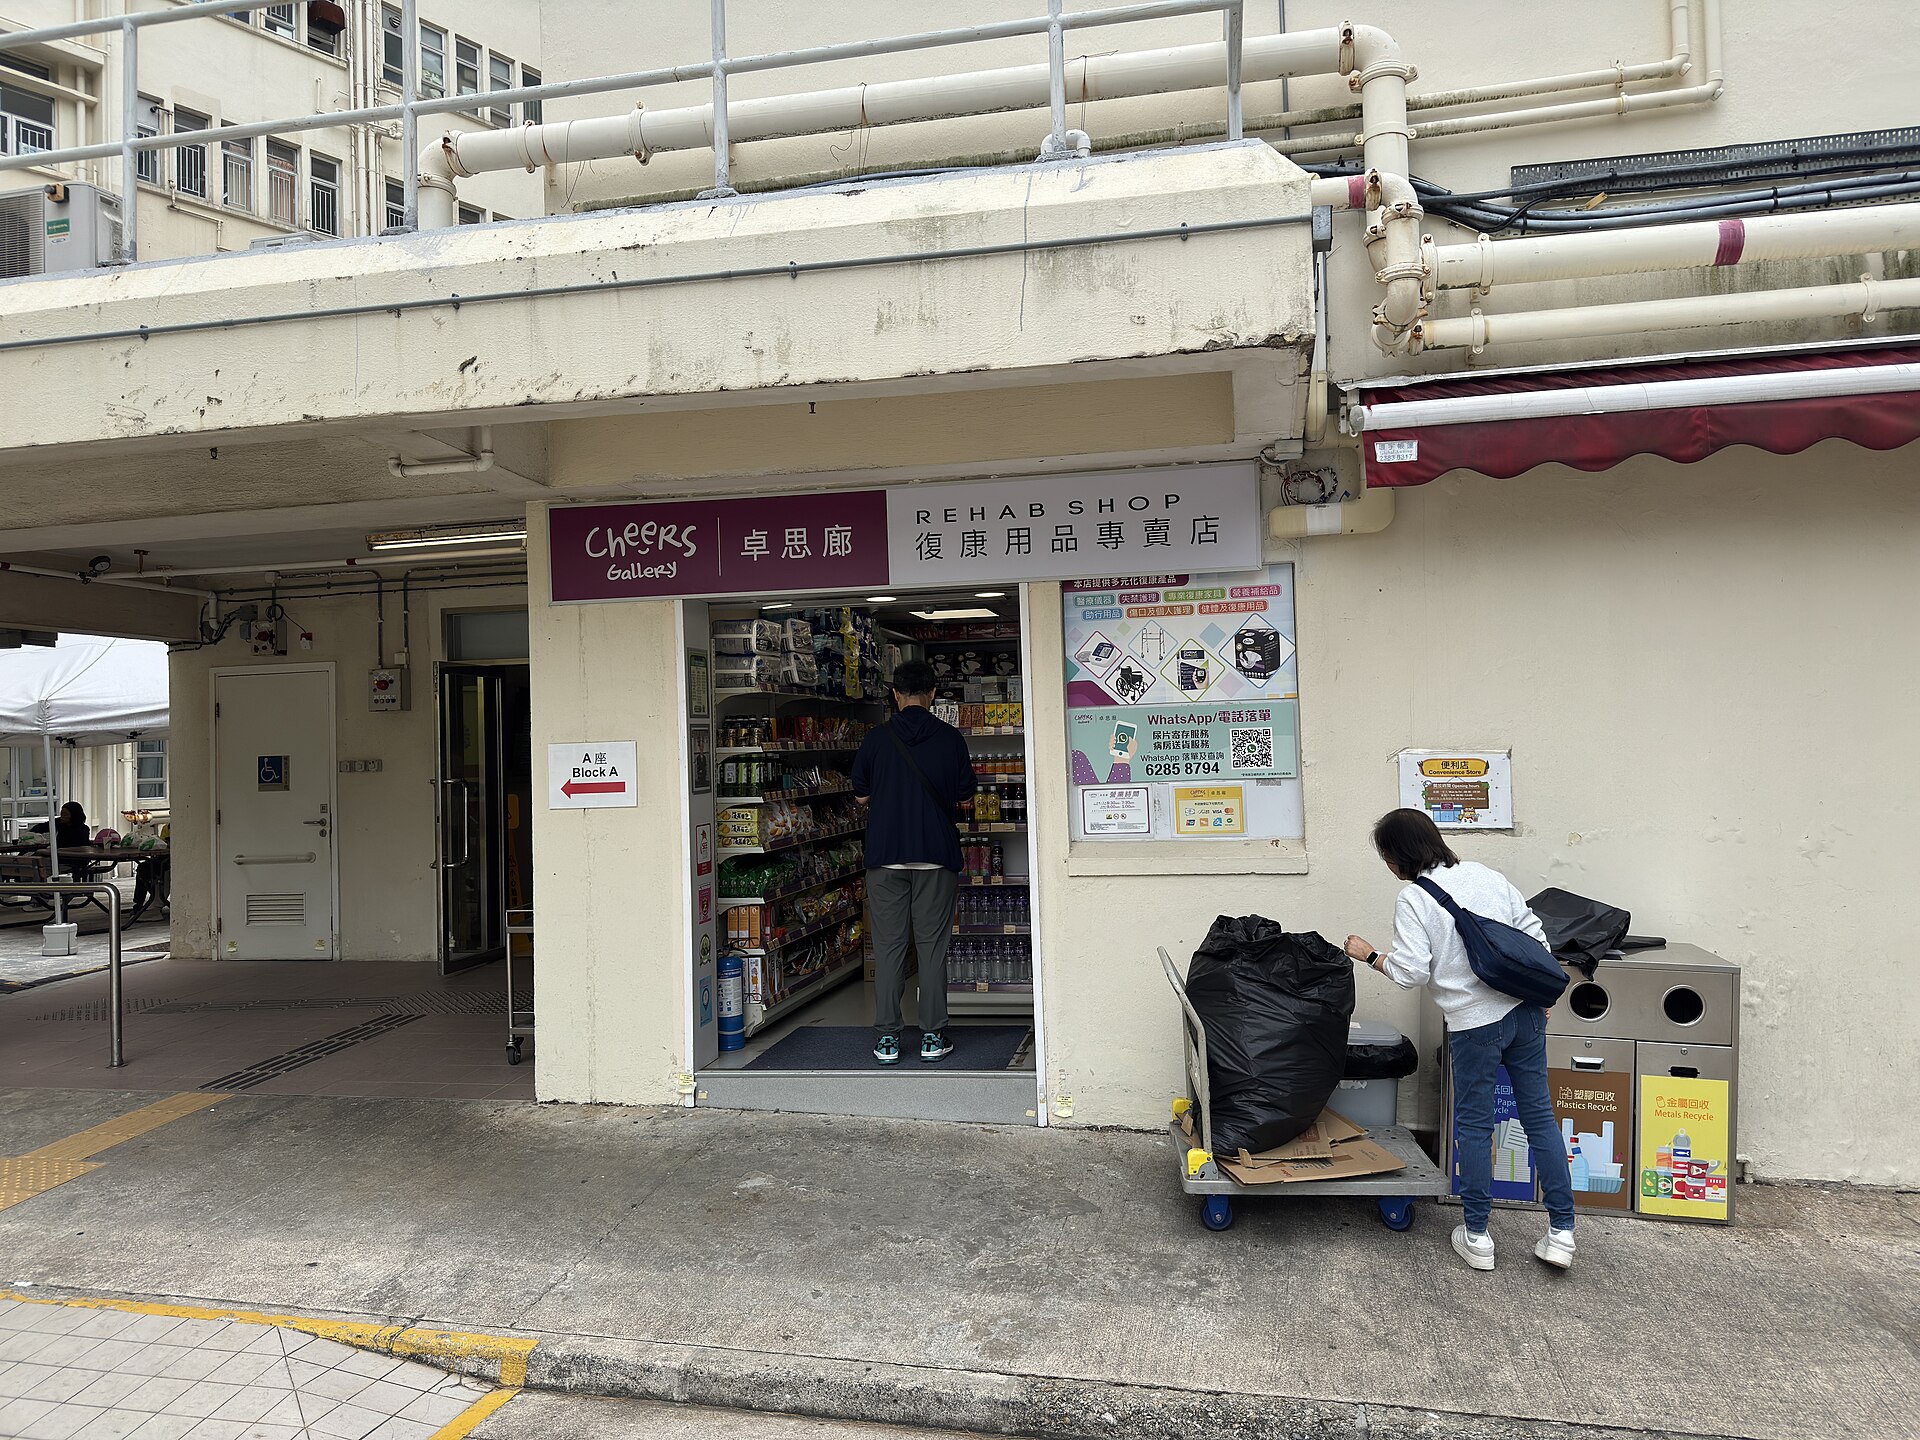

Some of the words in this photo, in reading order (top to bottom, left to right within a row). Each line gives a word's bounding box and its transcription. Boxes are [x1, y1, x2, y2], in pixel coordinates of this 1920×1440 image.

[916, 502, 1045, 525] REHAB
[1068, 494, 1181, 515] SHOP
[740, 523, 853, 562] 卓思廊
[915, 514, 1220, 561] 復康用品專賣店
[1120, 593, 1158, 604] 失禁護理
[1232, 586, 1279, 598] 營養補給品
[1085, 609, 1121, 620] 助行用品
[1152, 729, 1209, 740] 尿片寄存服務
[1153, 740, 1210, 750] 病房送貨服務
[582, 753, 592, 763] A
[594, 752, 607, 764] 座
[1140, 754, 1180, 762] WhatsApp
[1145, 763, 1180, 776] 6285
[1185, 762, 1220, 775] 8794
[1441, 760, 1469, 769] 便利店
[572, 767, 606, 778] Block
[609, 766, 619, 777] A
[1573, 1089, 1615, 1102] 塑膠回收
[1497, 1098, 1517, 1108] Pape
[1556, 1100, 1586, 1110] Plastics
[1587, 1103, 1617, 1112] Recycle
[1666, 1097, 1709, 1110] 金屬回收
[1493, 1106, 1509, 1115] ycle
[1654, 1109, 1682, 1119] Metals
[1683, 1111, 1714, 1121] Recycle
